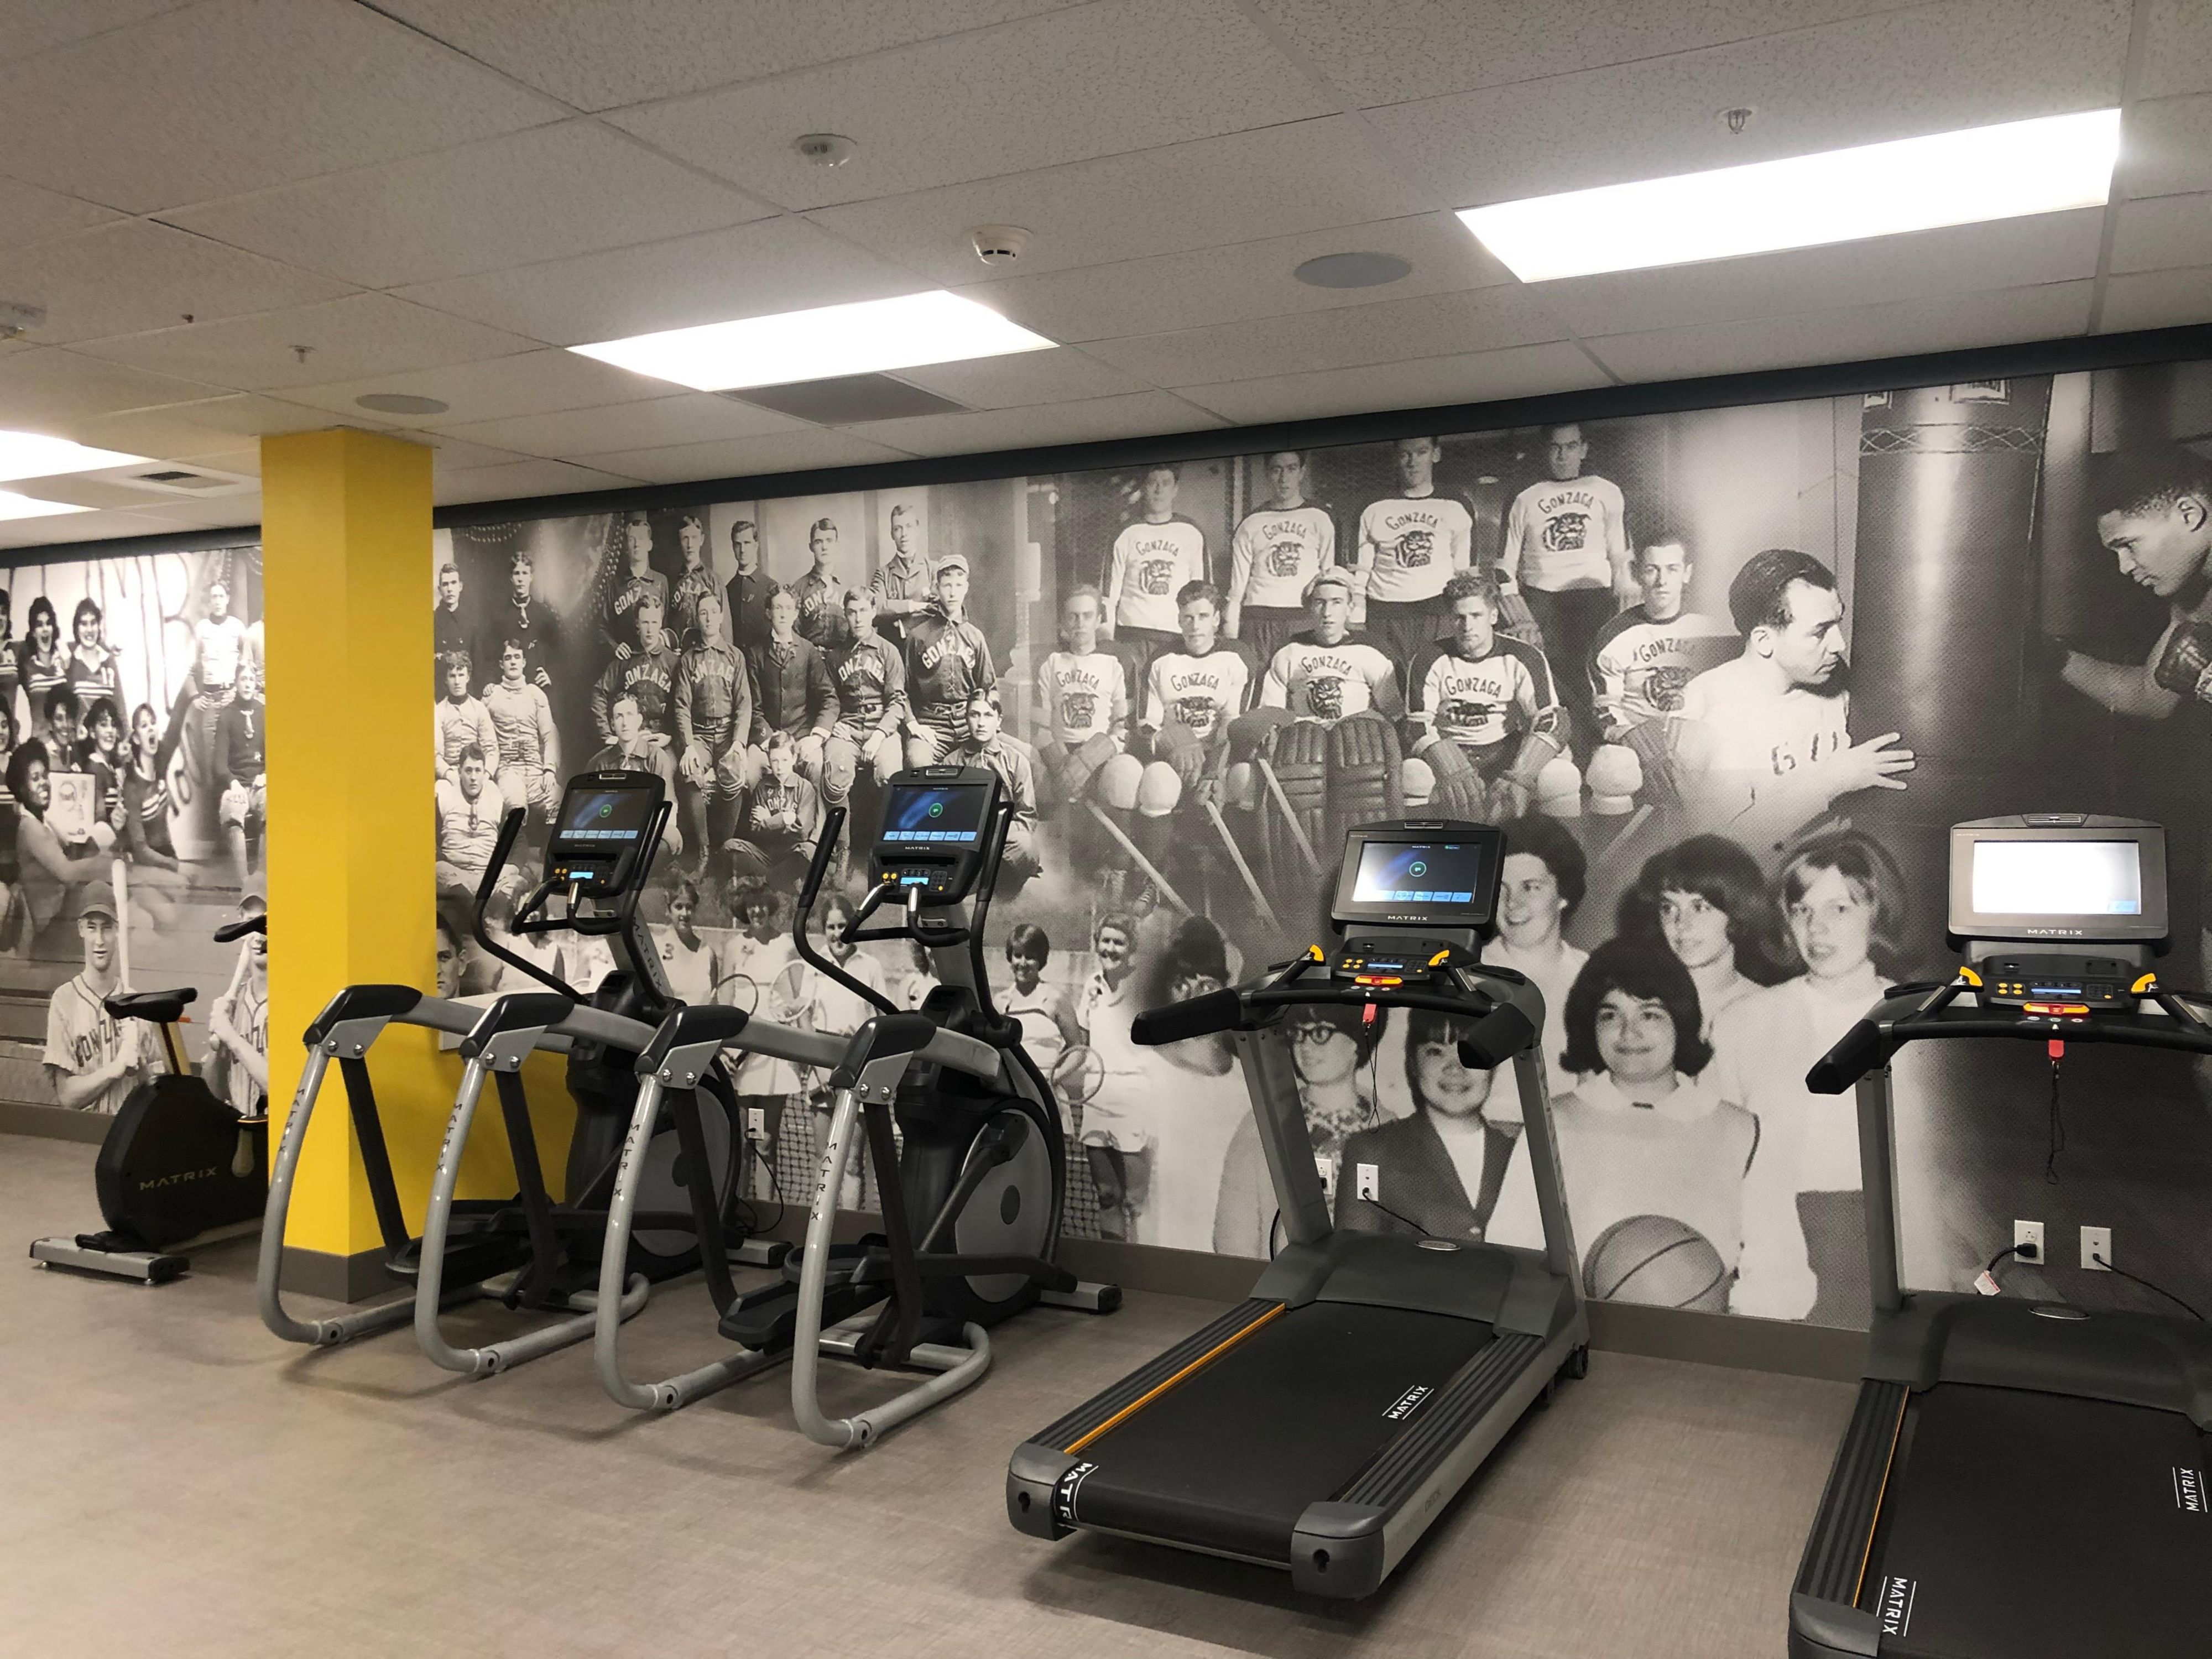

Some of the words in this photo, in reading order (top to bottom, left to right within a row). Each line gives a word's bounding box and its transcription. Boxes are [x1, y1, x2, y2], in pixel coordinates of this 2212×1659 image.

[1538, 492, 1593, 515] GONZAGA
[1262, 521, 1308, 541] GONZAGA
[1385, 512, 1439, 531] GONZAGA
[1135, 540, 1179, 557] GONZAGA
[1301, 656, 1352, 676] GONZAGA
[1056, 669, 1100, 690] GONZAGA
[1171, 673, 1219, 693] GONZAGA
[1444, 675, 1503, 698] GONZAGA
[436, 1103, 462, 1172] MATRIX
[613, 1124, 640, 1196] MATRX
[139, 1166, 218, 1191] MATRIX
[811, 1142, 837, 1220] MATRIX
[1387, 1386, 1428, 1419] MATRIX
[2180, 1468, 2200, 1511] MATRIX
[1882, 1577, 1907, 1635] MATRIX
